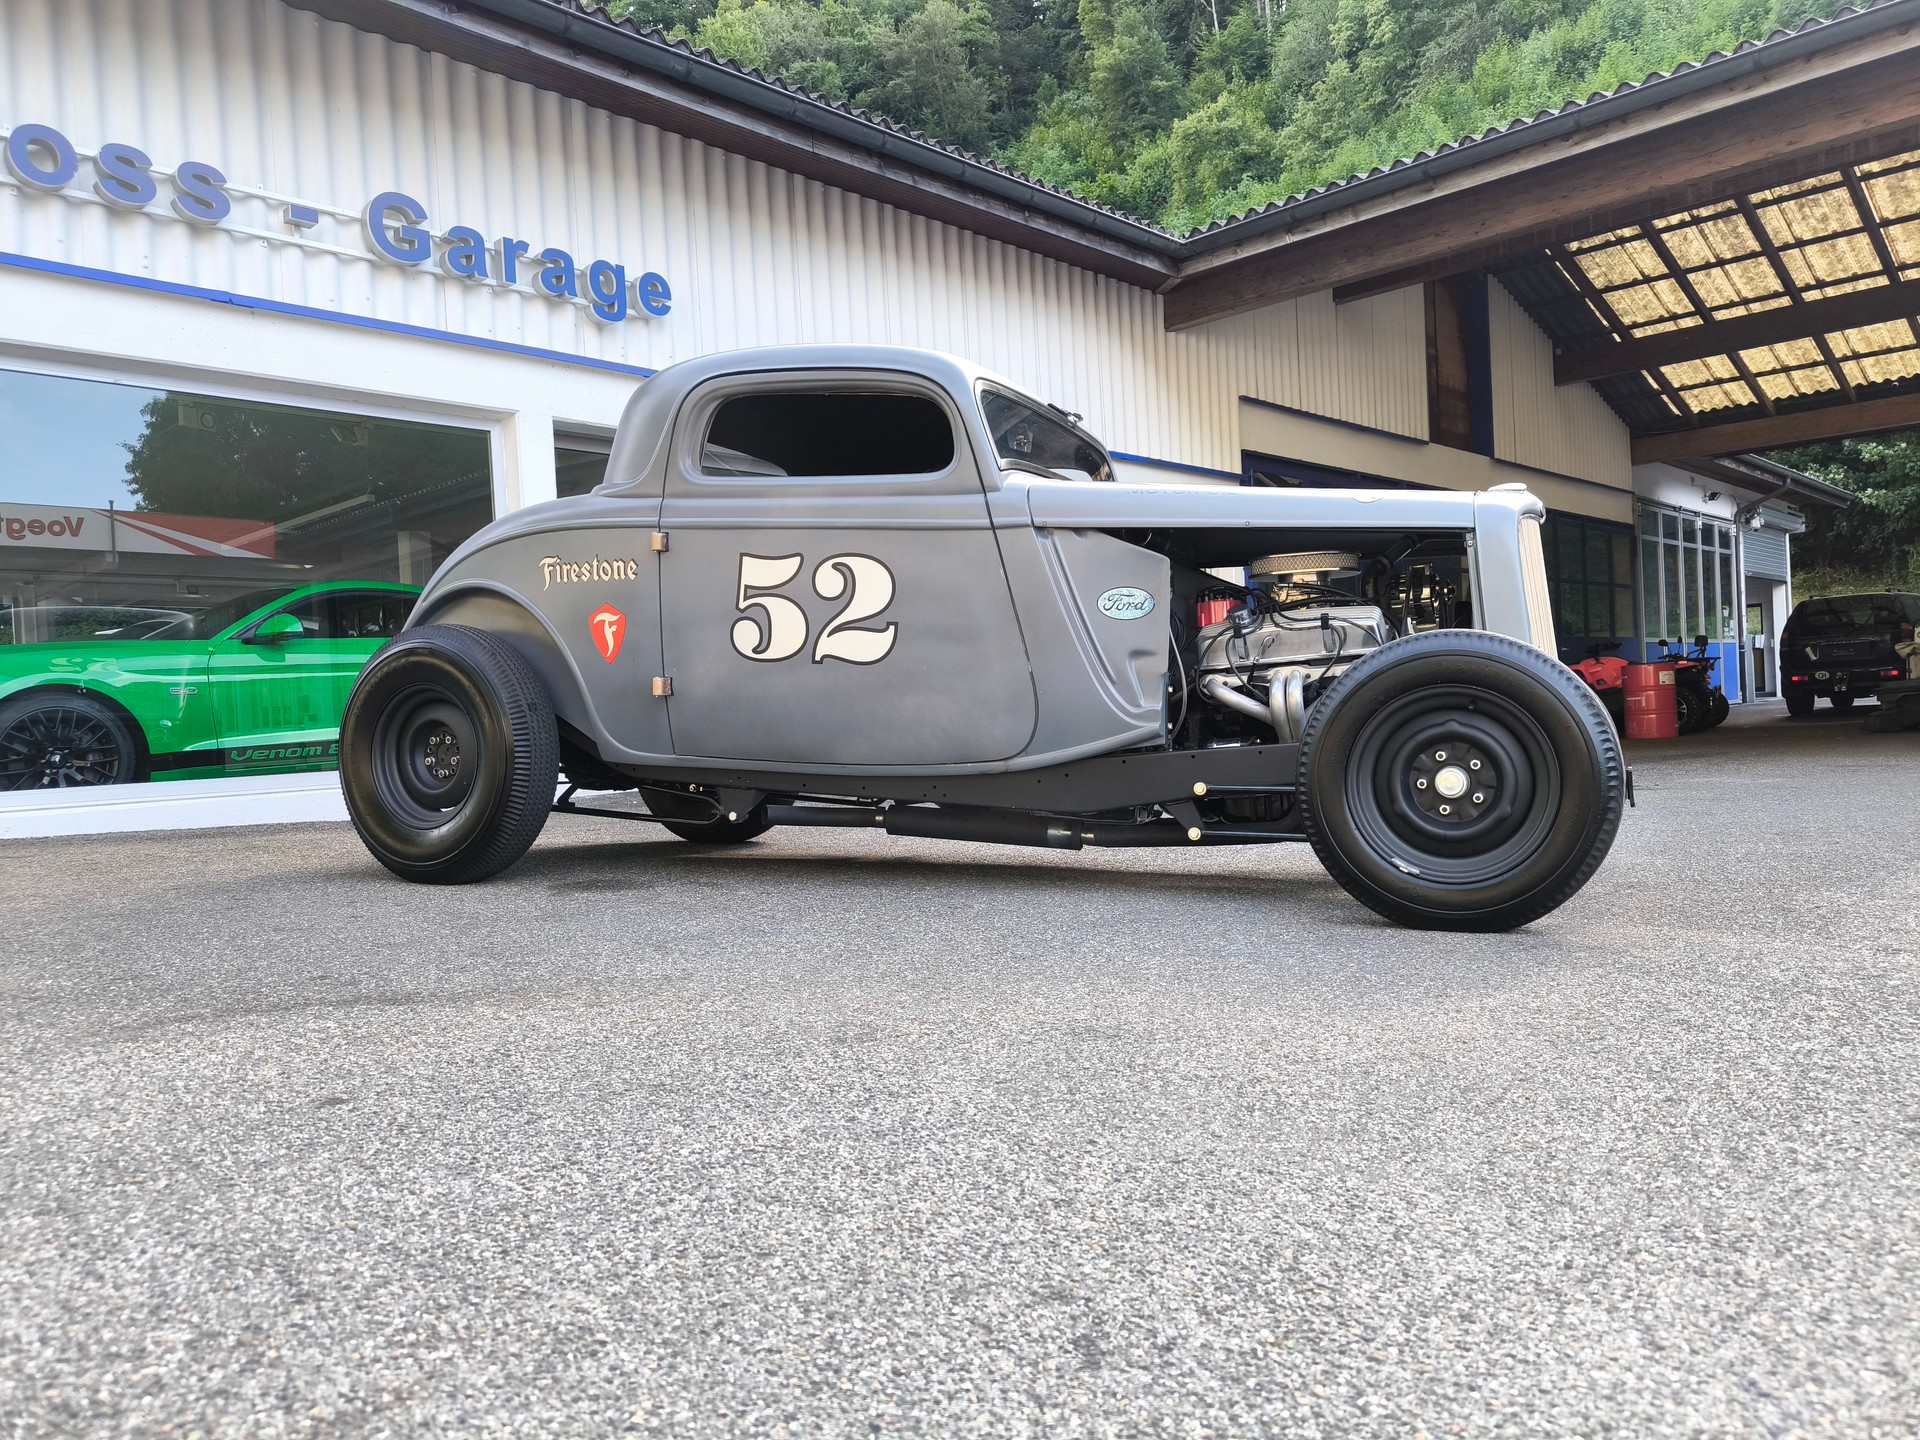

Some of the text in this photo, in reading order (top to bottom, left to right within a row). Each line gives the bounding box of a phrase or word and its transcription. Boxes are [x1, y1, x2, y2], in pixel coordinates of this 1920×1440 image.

[361, 191, 672, 326] Garage
[538, 553, 639, 592] Firestone
[730, 552, 899, 666] 52
[1103, 593, 1148, 611] Ford
[593, 612, 621, 658] F
[230, 746, 323, 761] Venom
